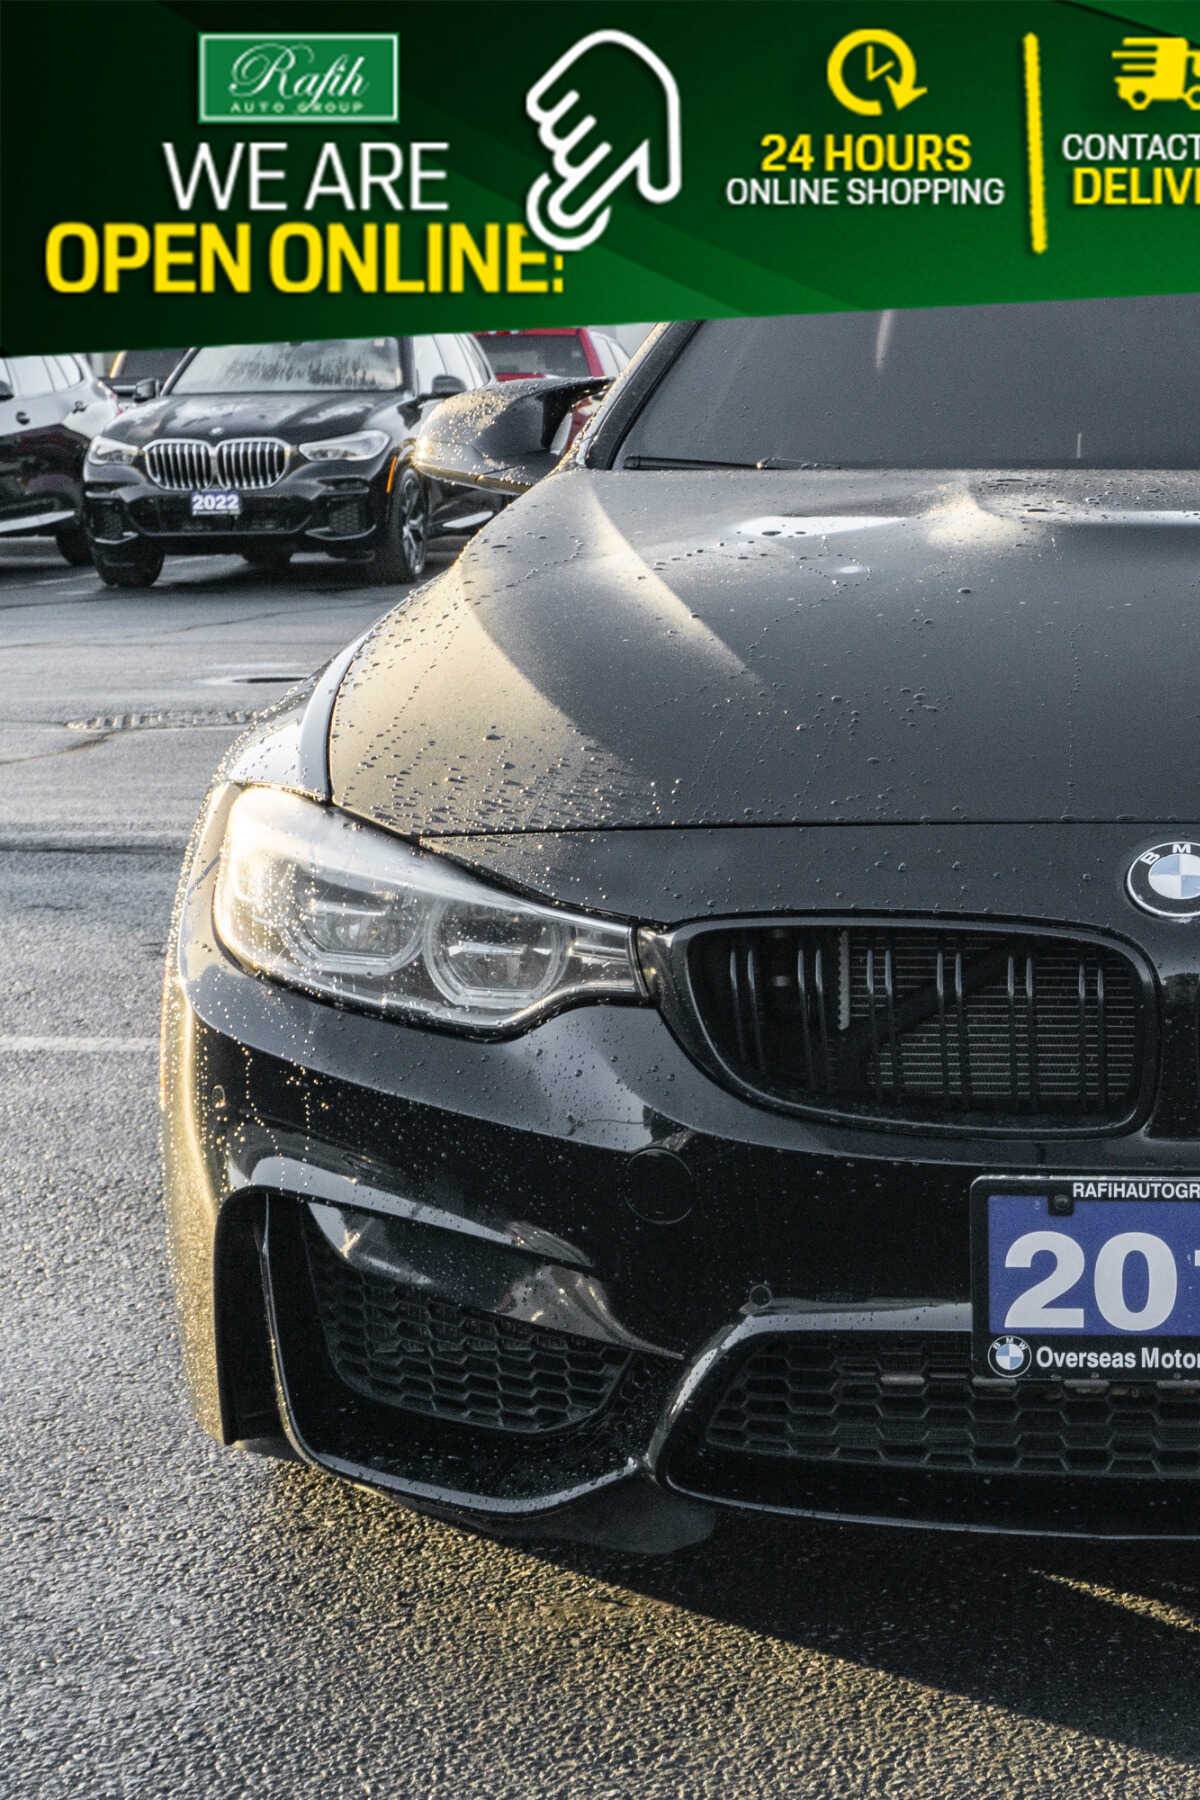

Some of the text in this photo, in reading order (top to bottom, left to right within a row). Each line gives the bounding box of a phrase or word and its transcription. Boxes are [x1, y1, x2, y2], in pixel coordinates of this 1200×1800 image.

[192, 494, 240, 510] 2022
[992, 1337, 1031, 1350] BMW
[1036, 1346, 1137, 1368] Overseas
